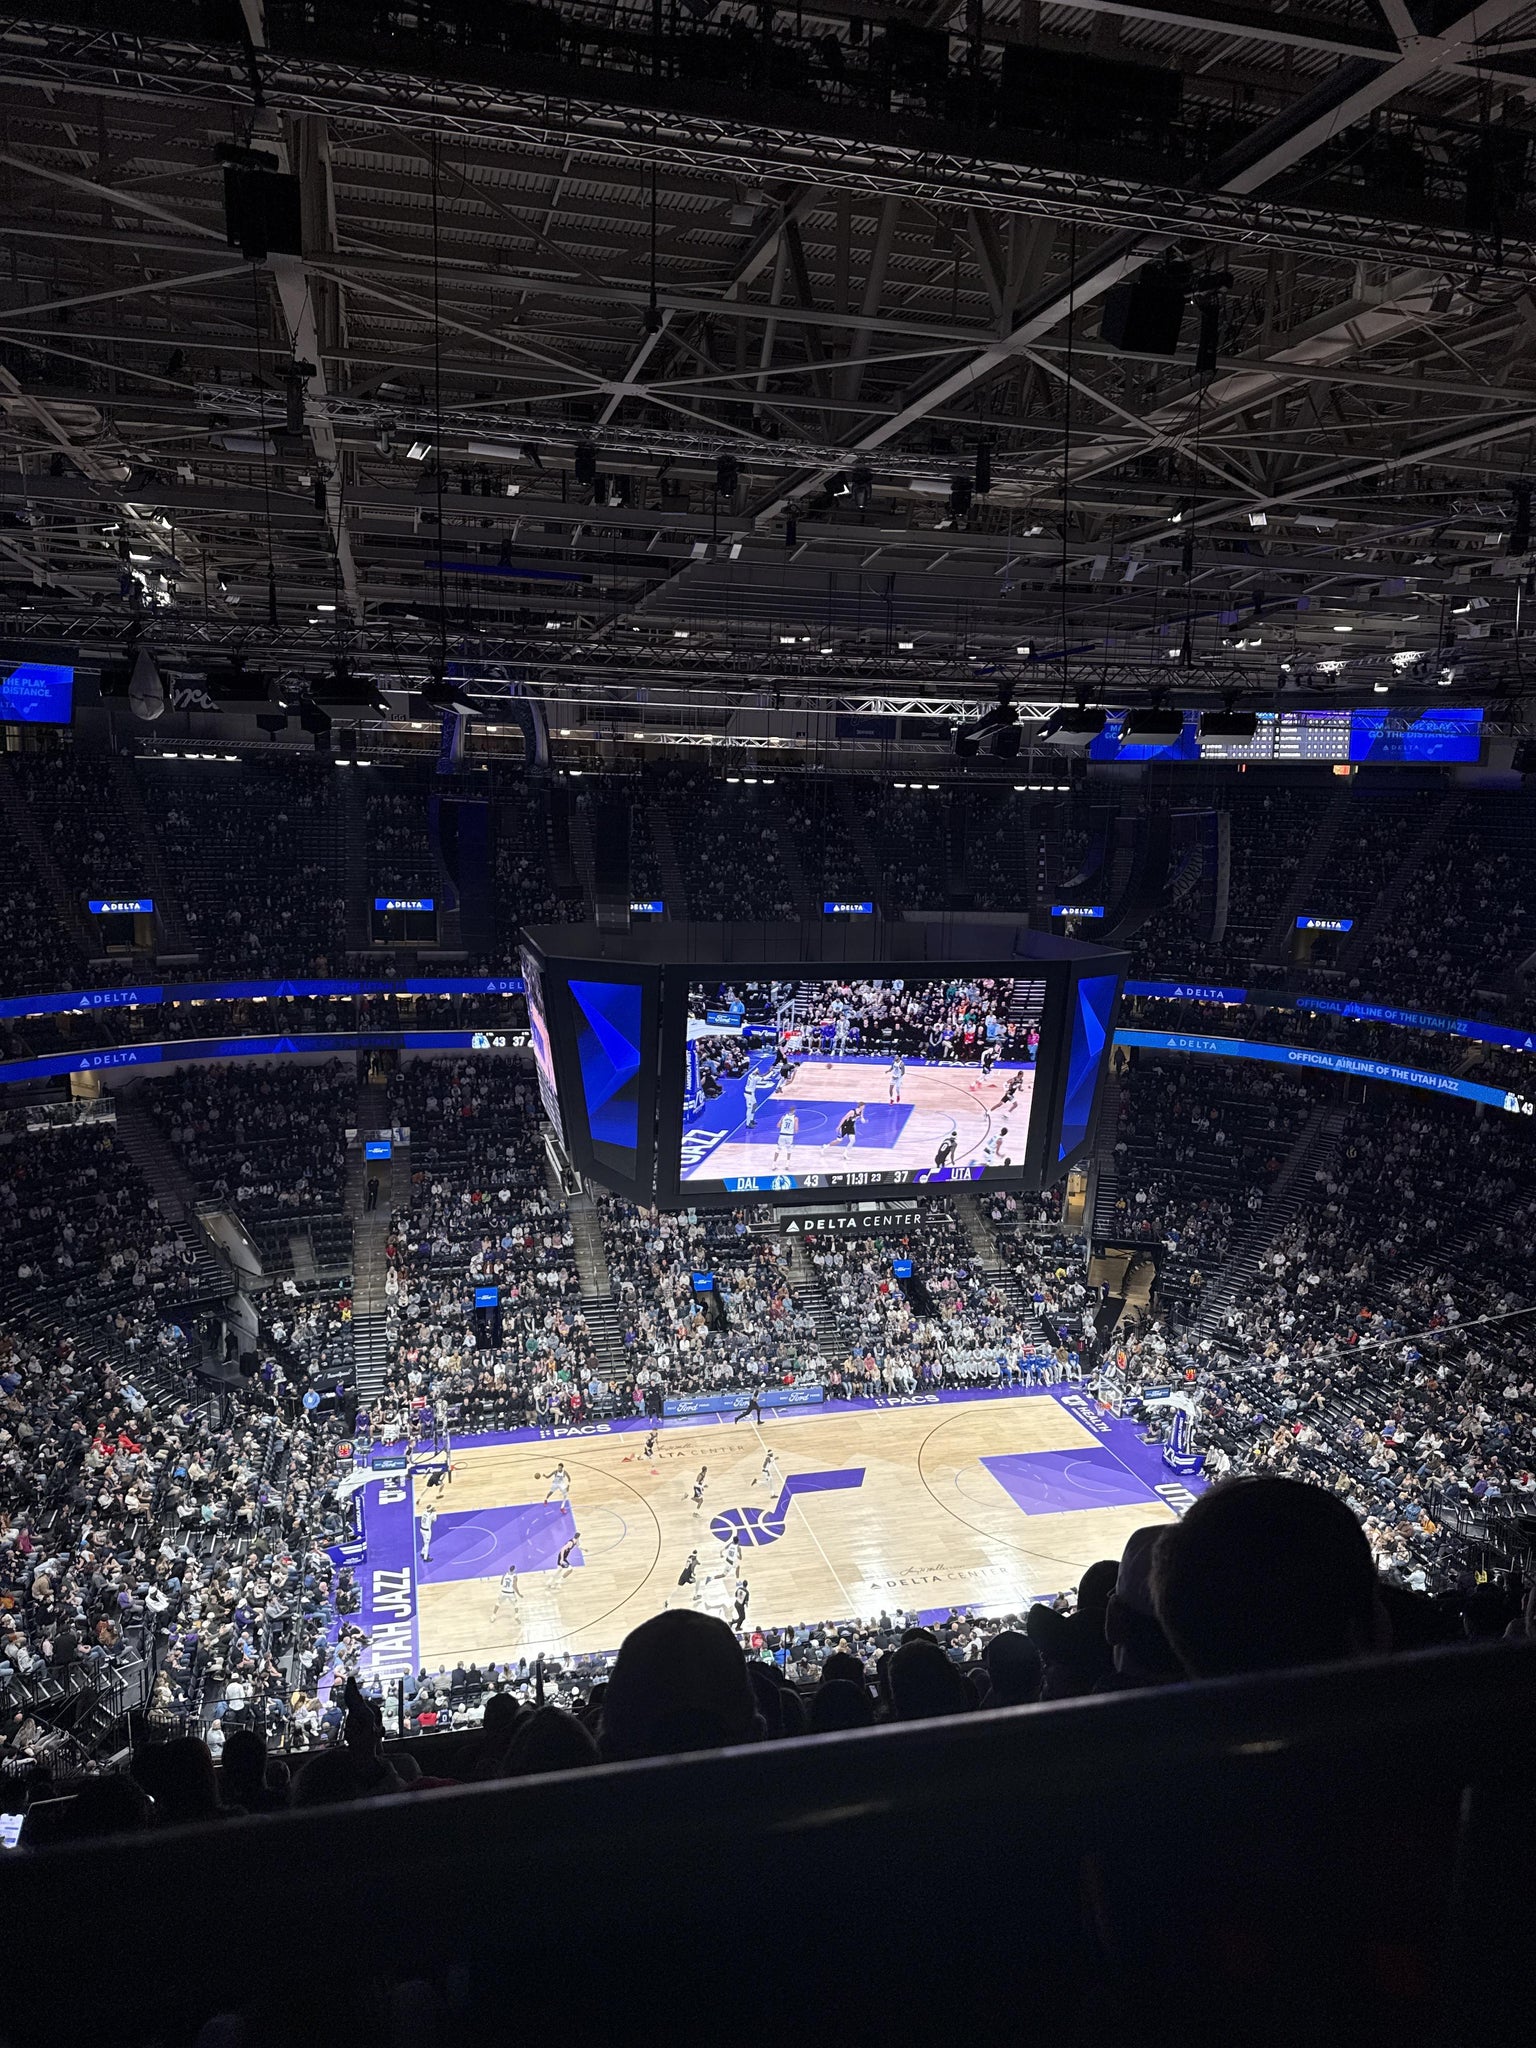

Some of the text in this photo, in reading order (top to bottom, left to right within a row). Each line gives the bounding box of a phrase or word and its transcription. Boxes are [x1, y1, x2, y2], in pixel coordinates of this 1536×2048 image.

[1315, 920, 1342, 928] DELTA
[500, 981, 523, 990] DEL
[94, 992, 138, 1004] DELTA
[1186, 988, 1224, 999] DELTA
[1297, 999, 1468, 1033] OFFICIAL AIRLINE OF THE UTAH JAZZ
[492, 1036, 525, 1047] 43 37
[1180, 1039, 1217, 1050] DELTA
[94, 1052, 137, 1066] DELTA
[1288, 1052, 1459, 1091] OFFICIAL AIRLINE OF THE UTAH JAZZ
[1521, 1101, 1534, 1115] 43
[737, 1177, 759, 1190] DAL
[803, 1174, 819, 1187] 43
[846, 1172, 868, 1186] 11:31
[870, 1173, 881, 1183] 23
[893, 1170, 909, 1183] 37
[951, 1167, 972, 1180] UTA
[803, 1213, 922, 1231] DELTA CENTER
[789, 1391, 810, 1403] Ford
[886, 1394, 940, 1406] PACS
[676, 1401, 699, 1412] Ford
[1077, 1406, 1112, 1432] HEALTH
[553, 1423, 611, 1438] PACS
[690, 1445, 745, 1456] CENTER
[1154, 1482, 1199, 1516] UTA
[886, 1575, 942, 1588] DELTA
[947, 1566, 1009, 1581] CENTER
[372, 1566, 413, 1682] UTAH JAZZ
